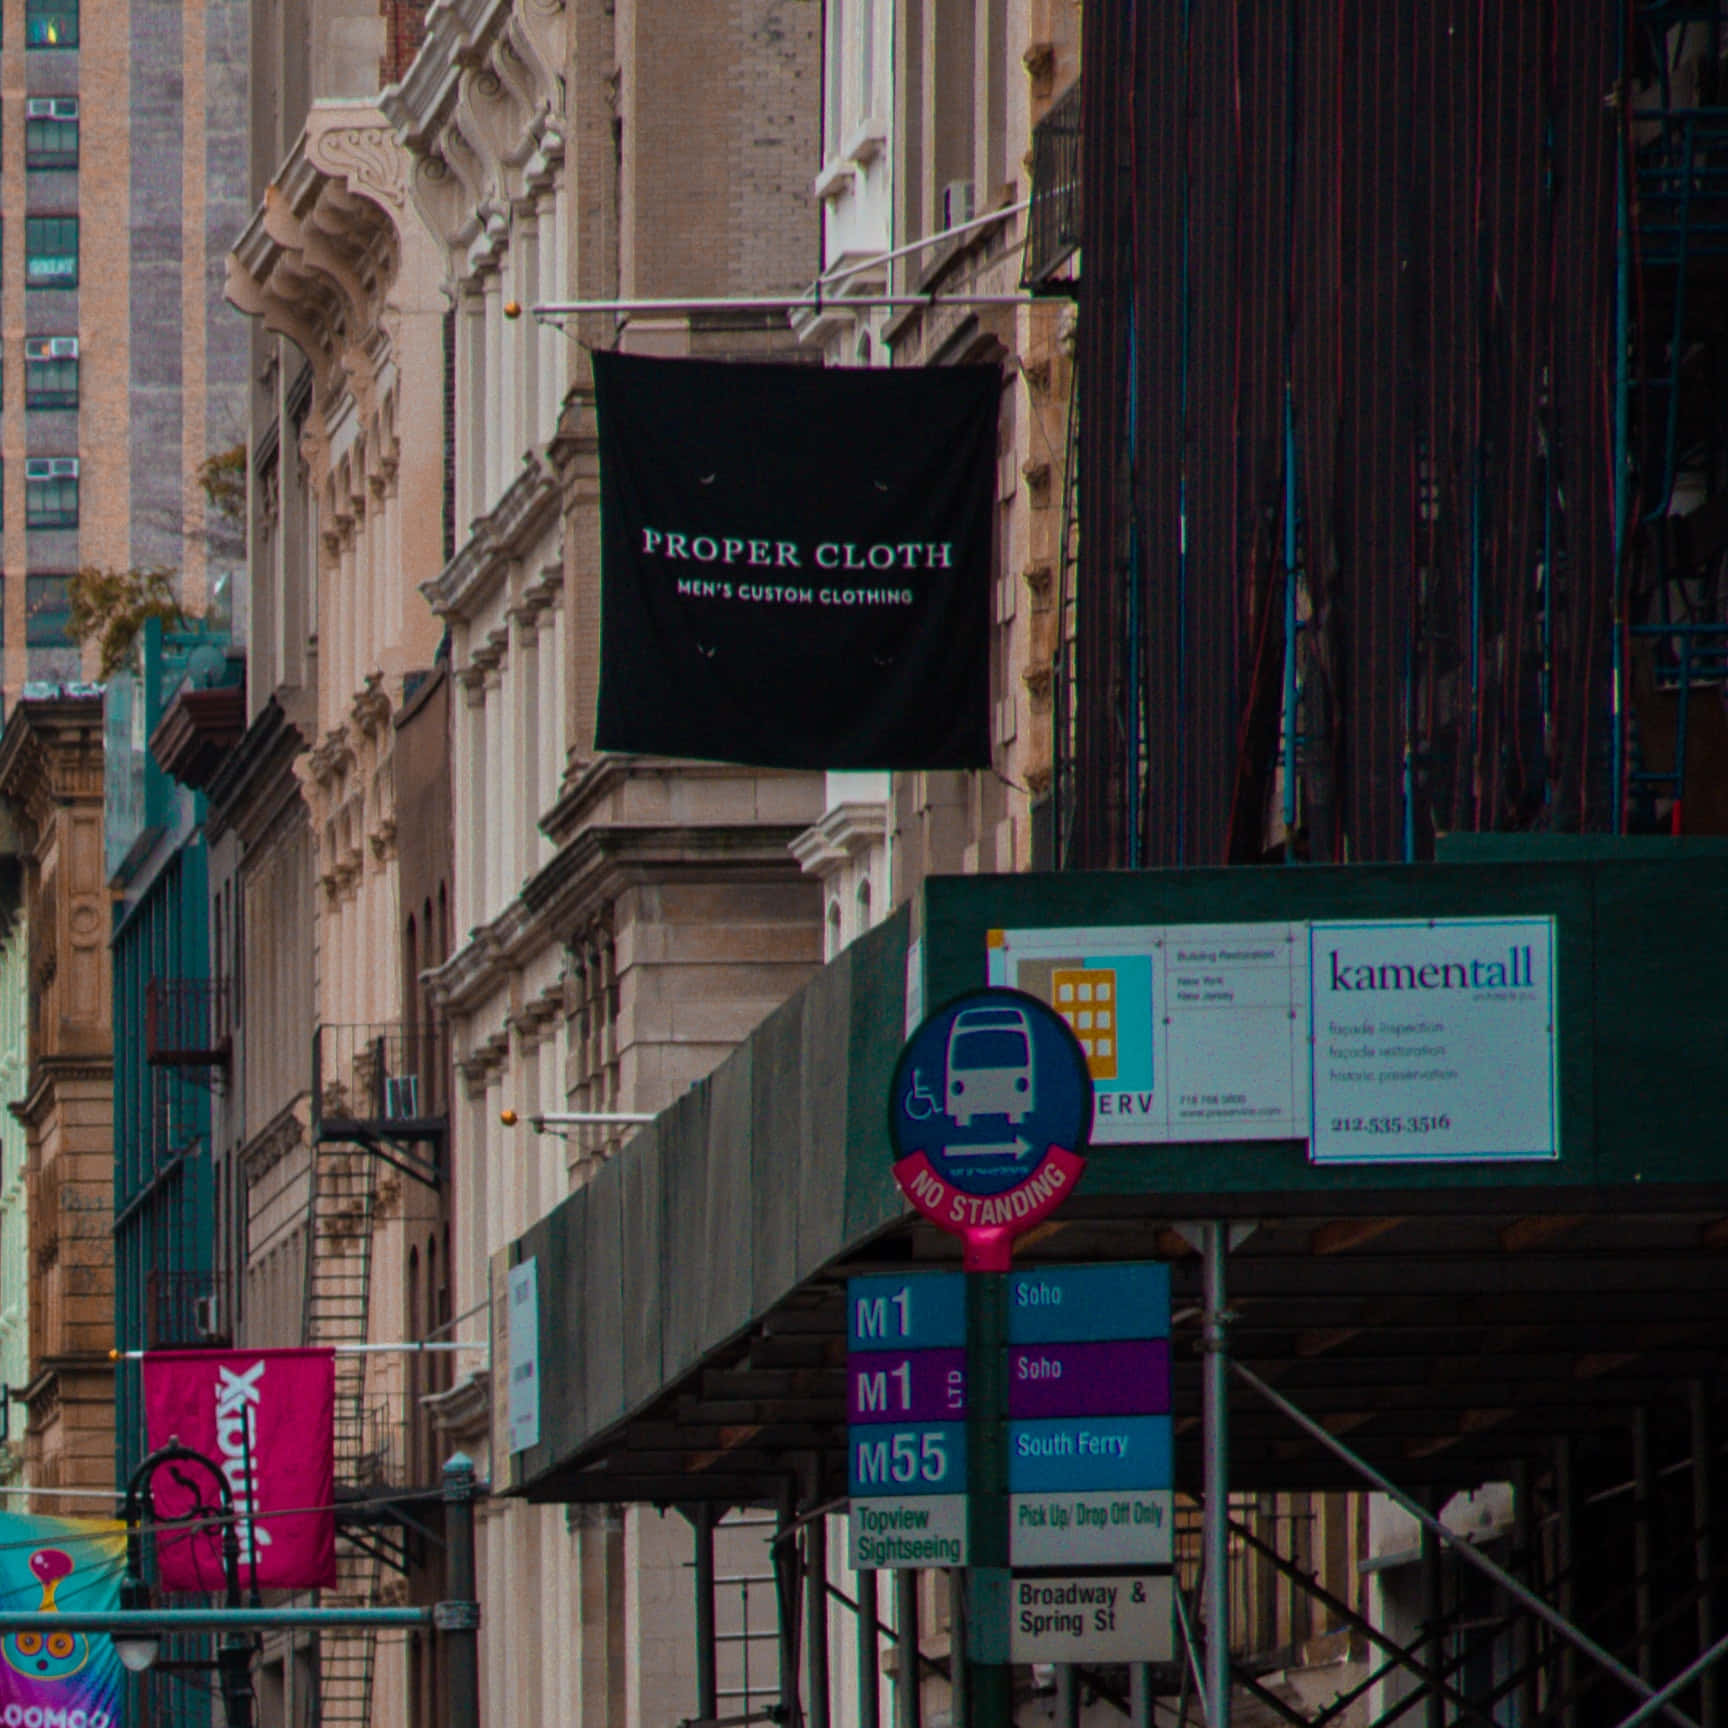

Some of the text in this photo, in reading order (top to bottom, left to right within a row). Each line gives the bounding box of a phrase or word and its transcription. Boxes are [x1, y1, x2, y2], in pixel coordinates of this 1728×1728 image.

[641, 526, 953, 569] PROPER CLOTH
[676, 577, 913, 606] MEN'S CUSTOM CLOTHING
[1176, 950, 1216, 962] Building
[1328, 946, 1536, 991] kamentall
[1379, 1021, 1445, 1037] inspection
[1378, 1045, 1446, 1057] restoration
[1329, 1069, 1459, 1083] historic preservation
[1331, 1113, 1451, 1135] 212.535.3516
[910, 1163, 1068, 1226] NO STANDING
[1015, 1282, 1062, 1306] Soho
[856, 1285, 912, 1338] M1
[1017, 1355, 1064, 1380] Soho
[857, 1359, 964, 1412] M1 LTD
[857, 1431, 946, 1485] M55
[1016, 1432, 1130, 1458] South Ferry
[858, 1506, 929, 1533] Topview
[1018, 1504, 1047, 1527] Pick
[1076, 1502, 1109, 1529] Drop
[1111, 1501, 1131, 1523] Off
[1133, 1500, 1162, 1528] Only
[858, 1535, 961, 1565] Sightseeing
[1019, 1581, 1147, 1609] Broadway &
[1019, 1606, 1116, 1636] Spring St
